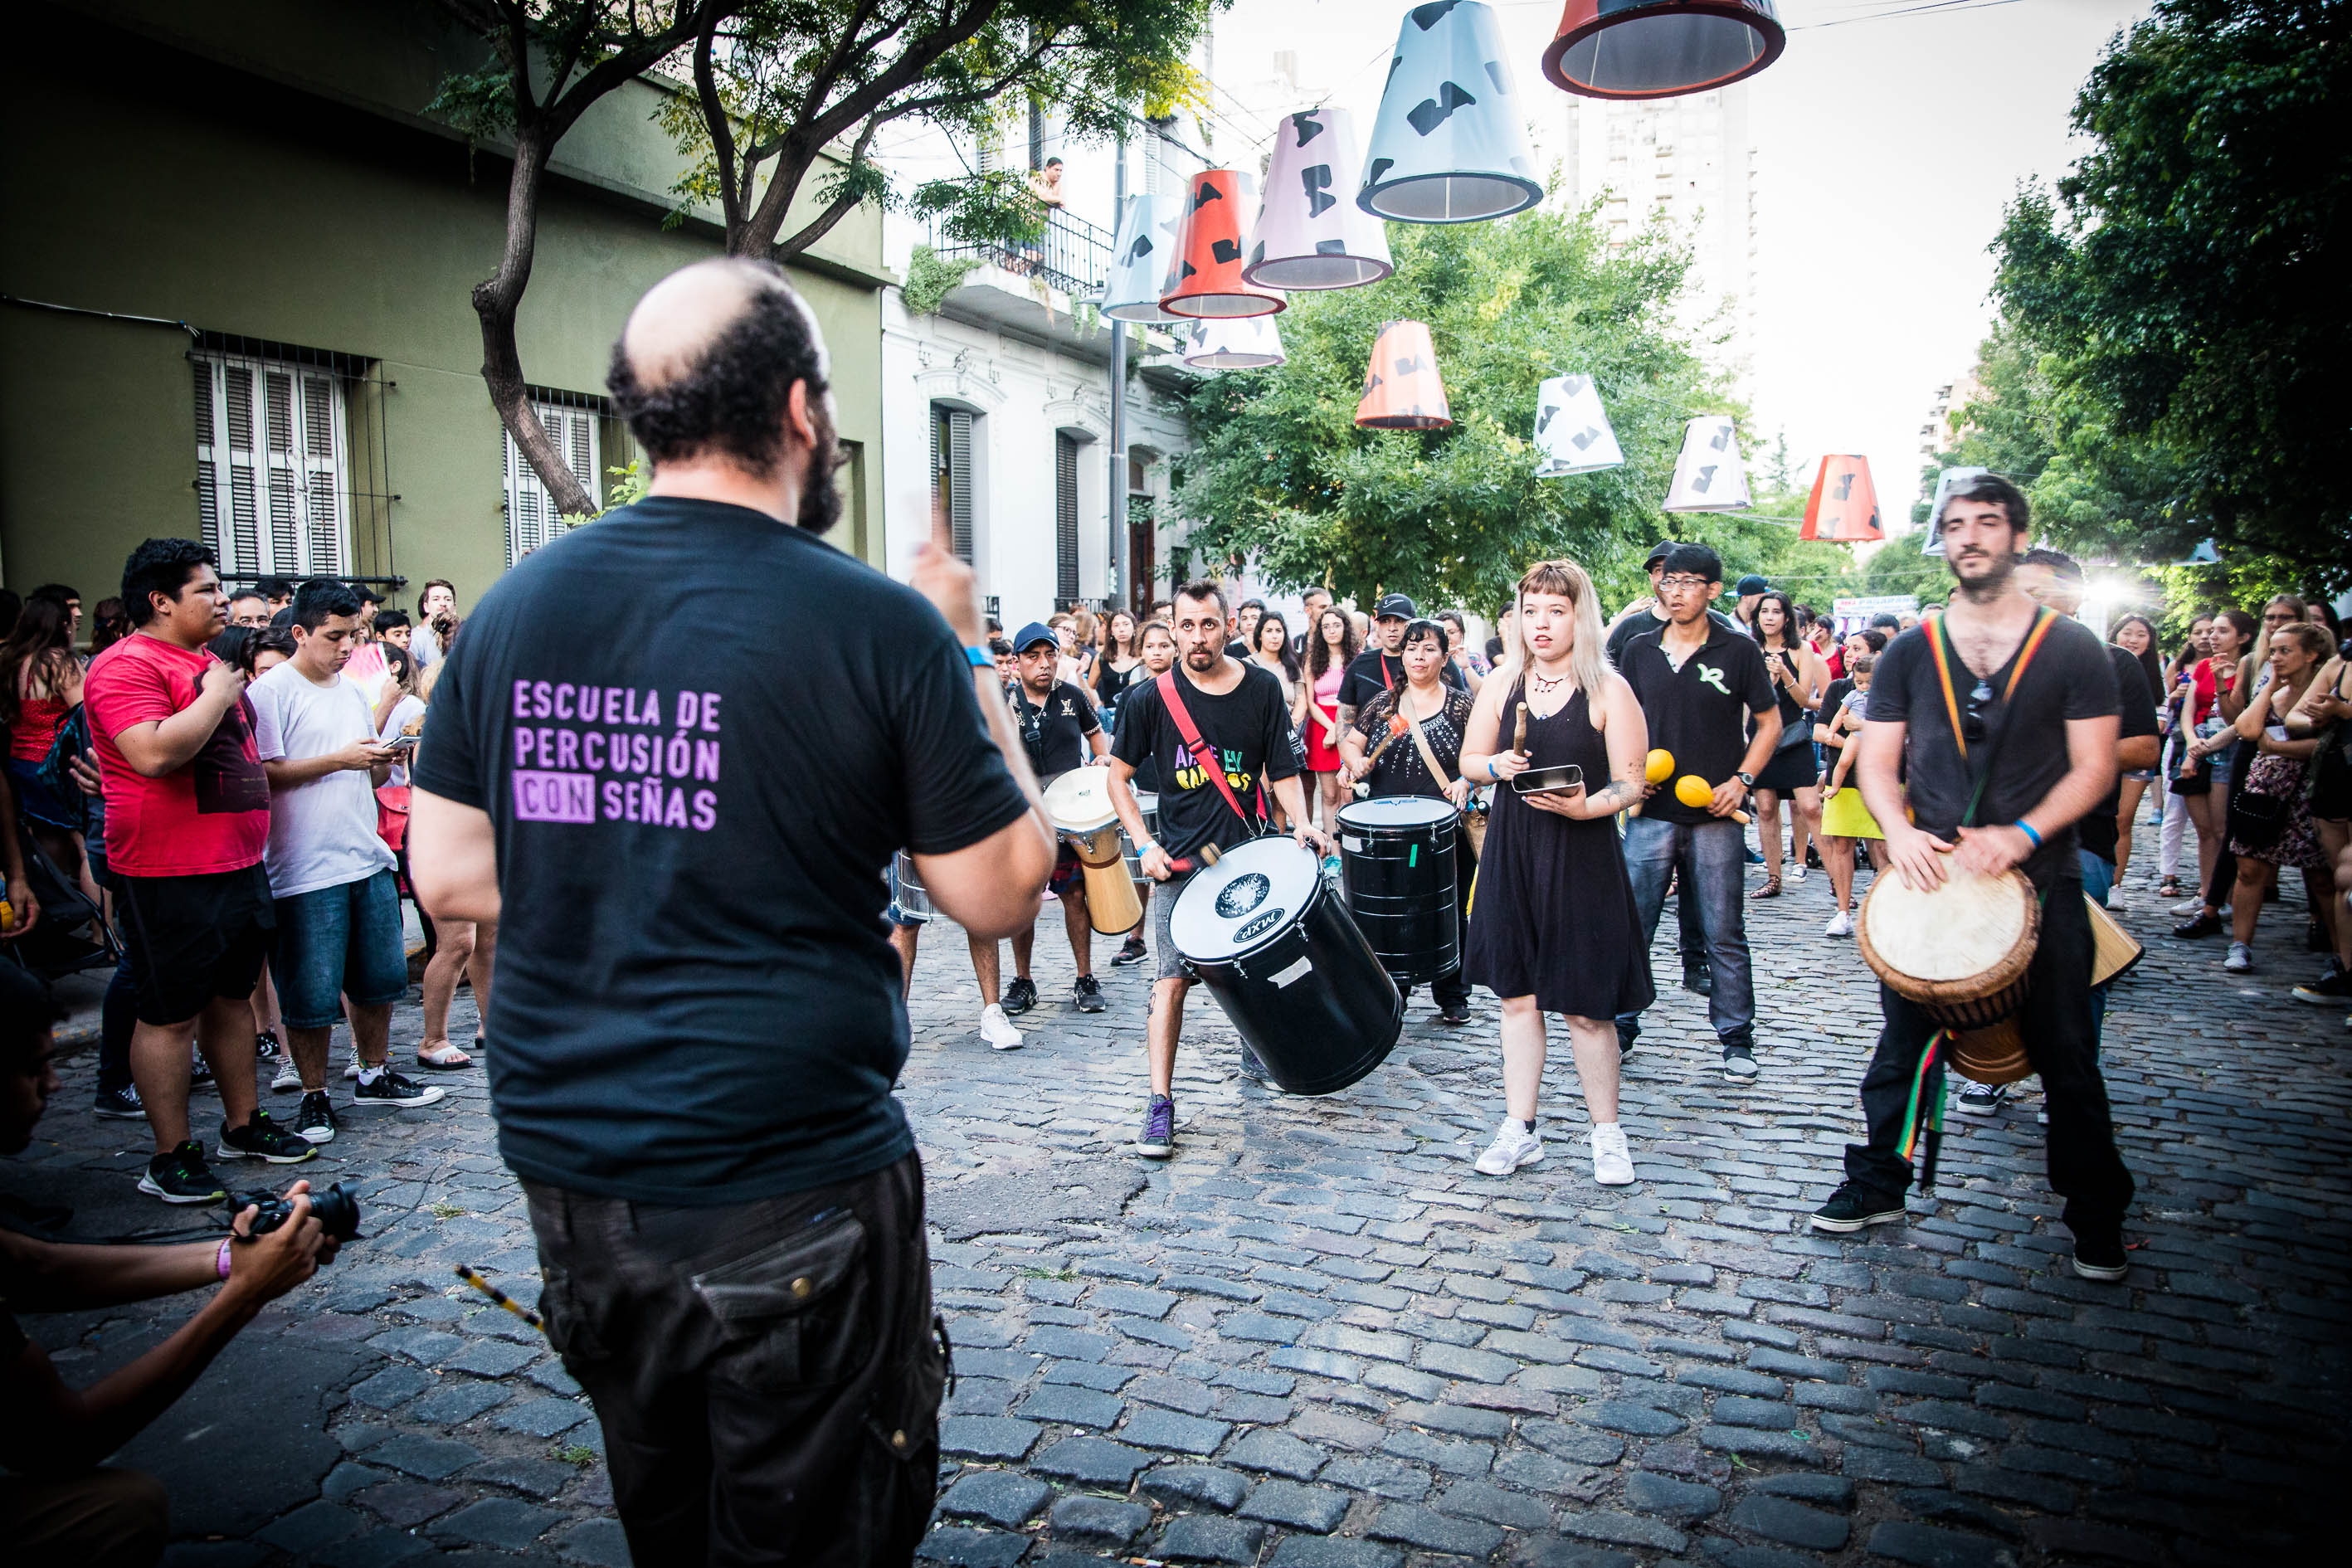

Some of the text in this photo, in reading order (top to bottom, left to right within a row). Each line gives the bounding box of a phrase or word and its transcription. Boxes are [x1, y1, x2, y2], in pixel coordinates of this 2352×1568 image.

[513, 679, 722, 733] ESCUELA DE
[513, 726, 721, 782] PERCUSIÓN
[521, 777, 718, 831] CON SEÑAS
